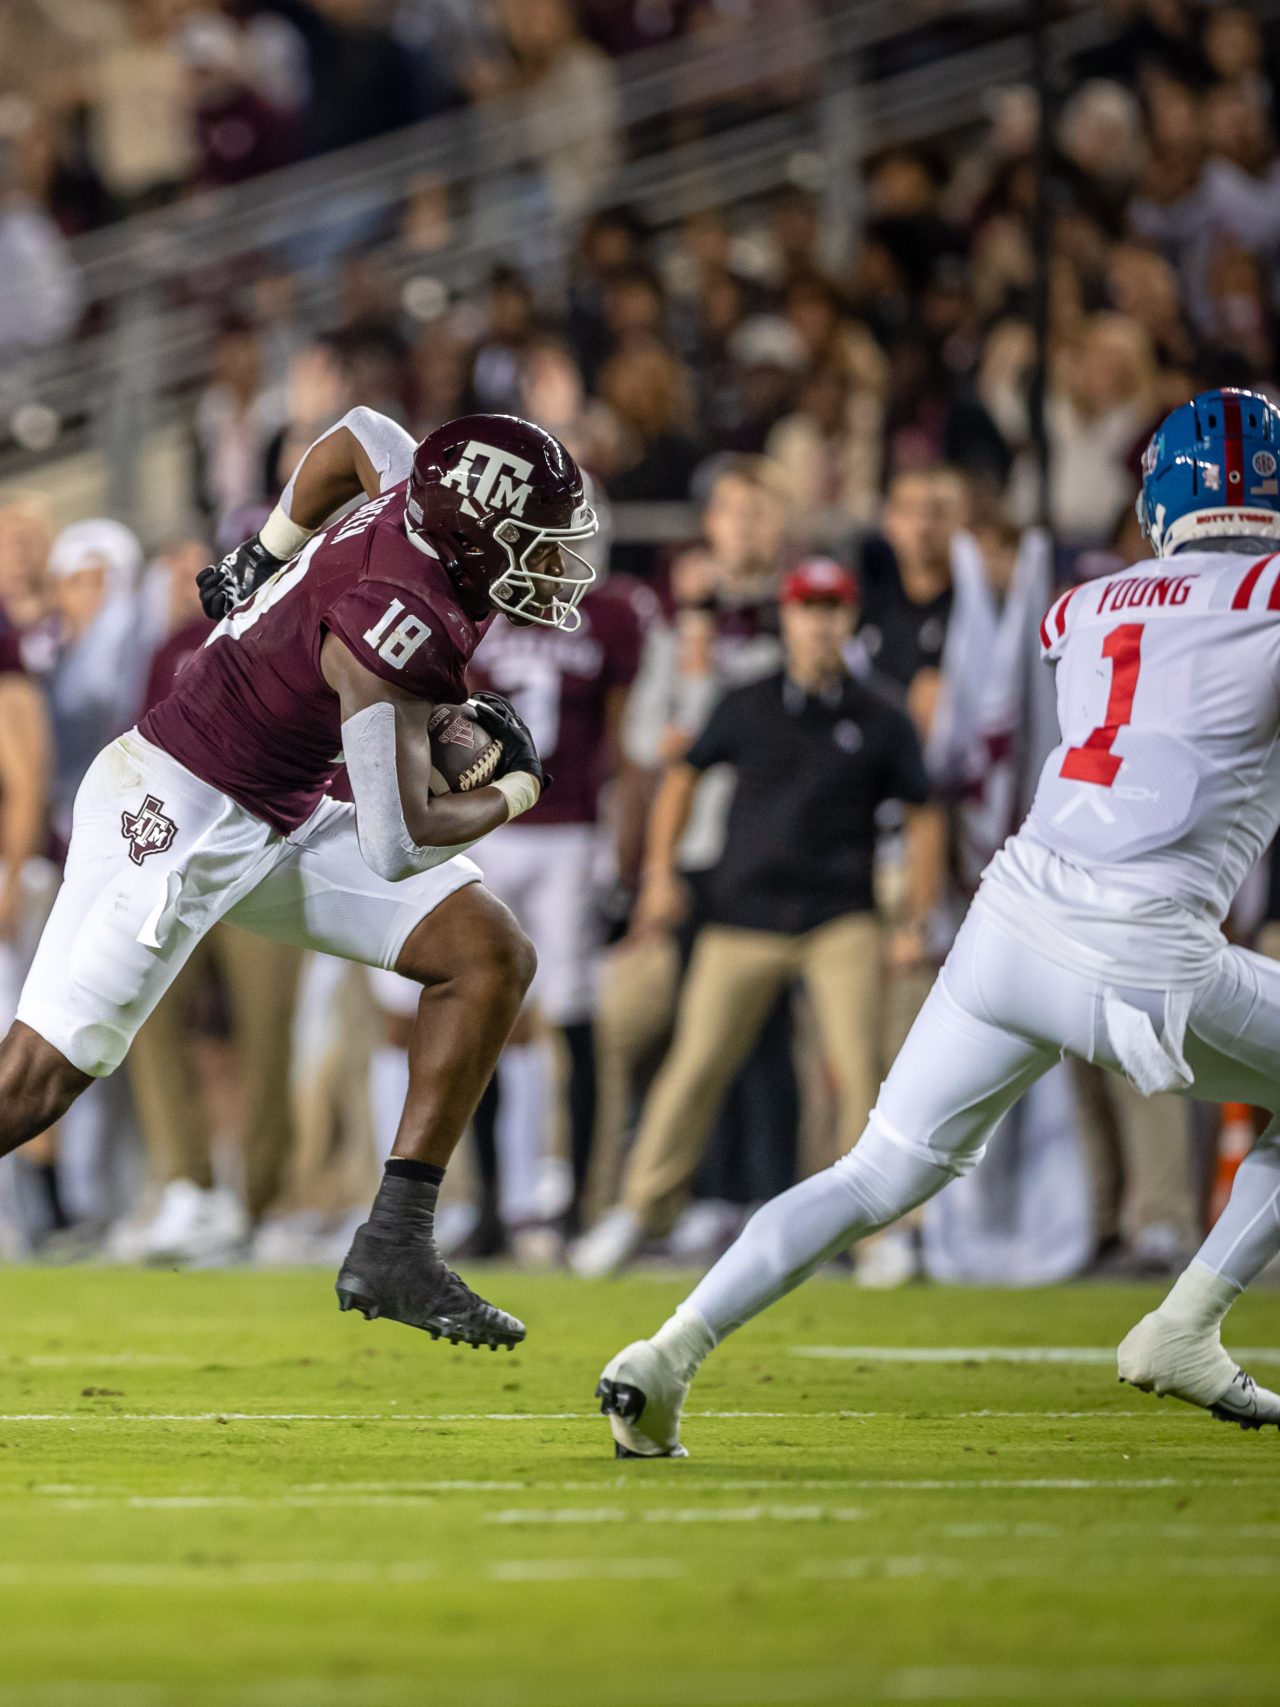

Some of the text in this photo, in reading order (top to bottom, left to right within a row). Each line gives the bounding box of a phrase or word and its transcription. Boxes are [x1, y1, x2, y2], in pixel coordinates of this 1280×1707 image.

[1096, 574, 1201, 615] YOUNG
[362, 598, 432, 670] 18
[1059, 623, 1145, 788] 1
